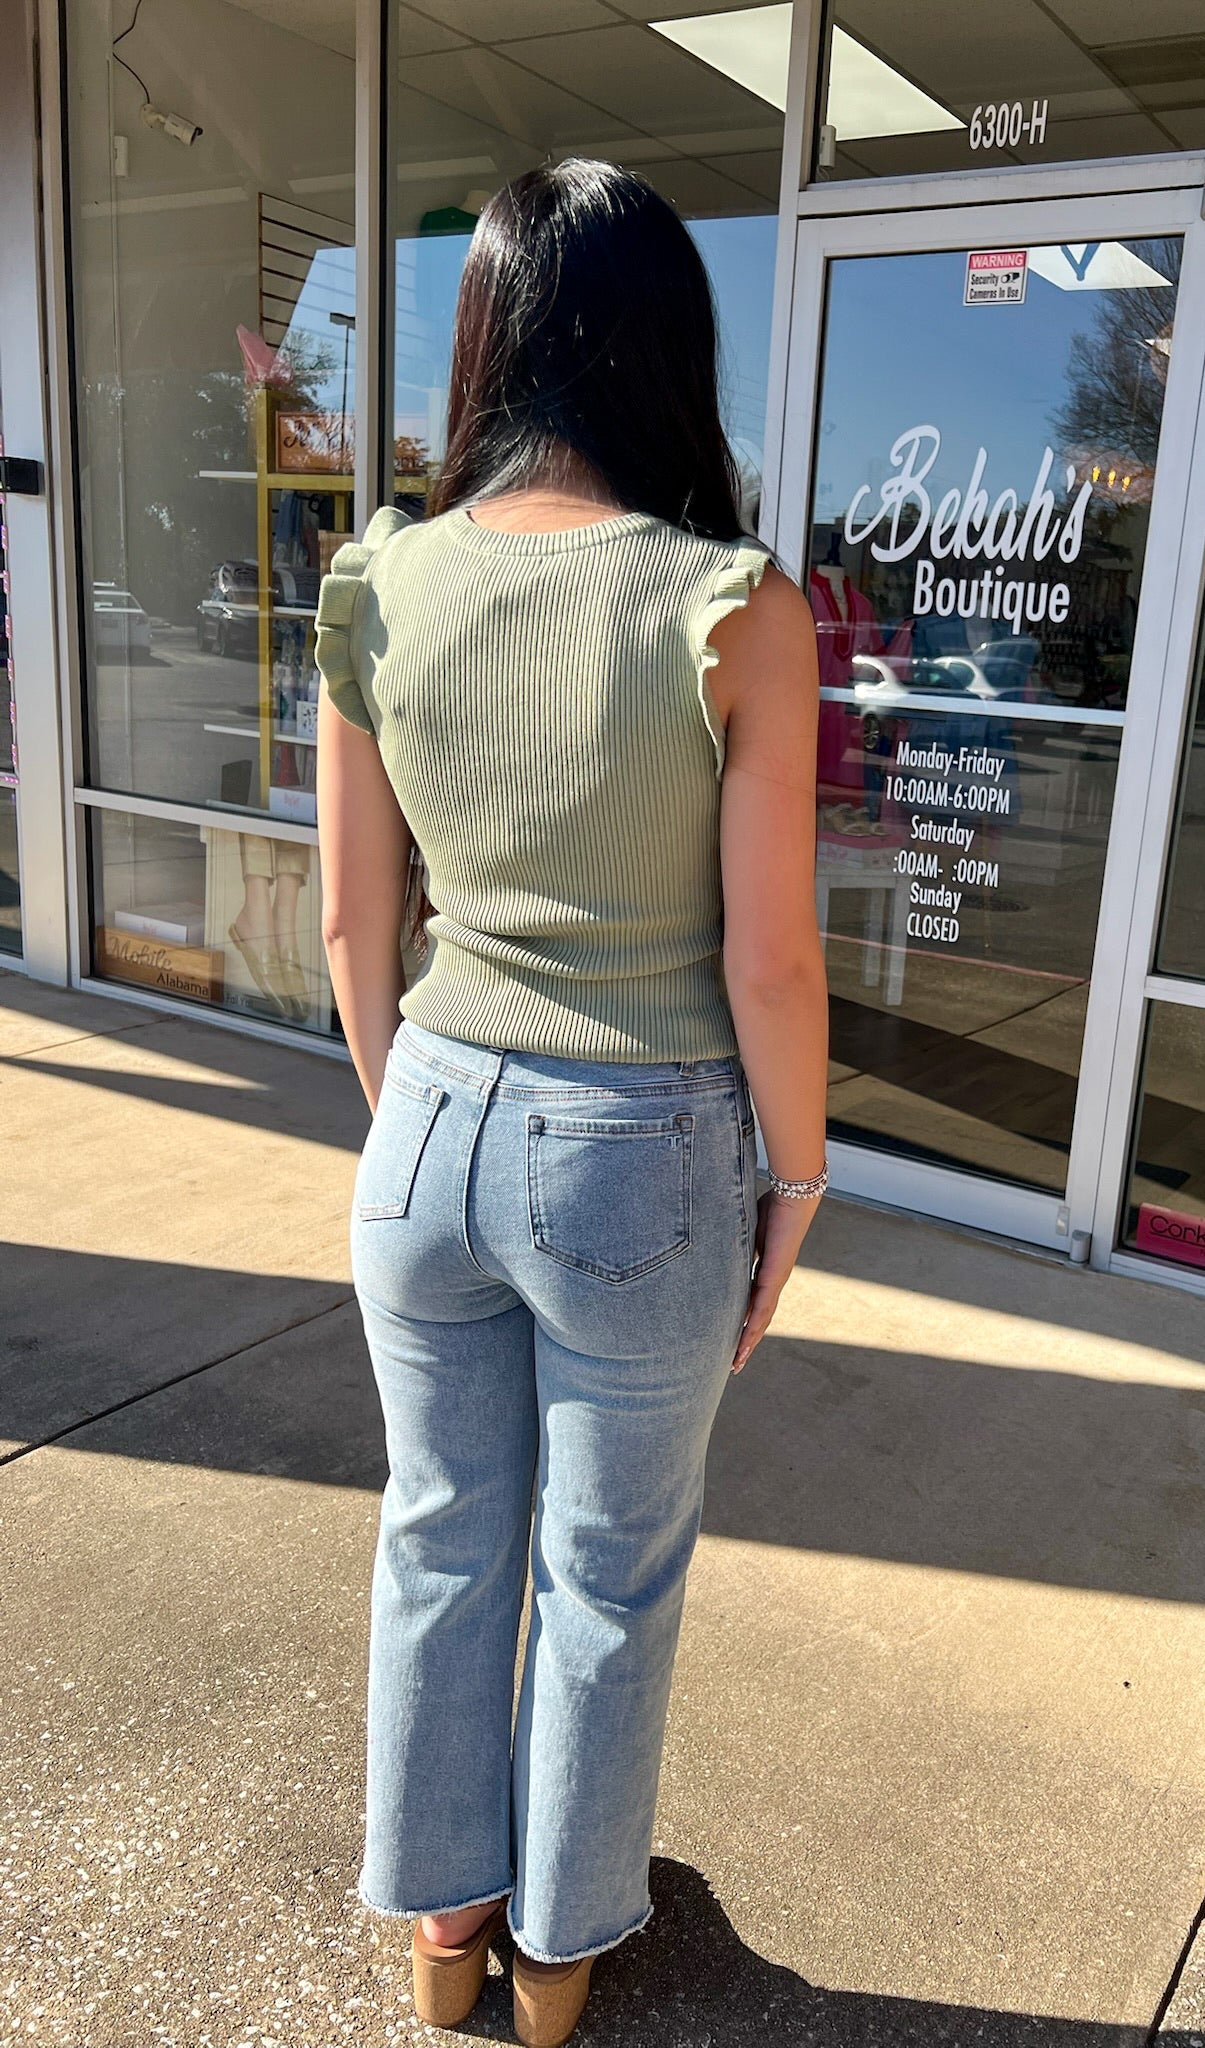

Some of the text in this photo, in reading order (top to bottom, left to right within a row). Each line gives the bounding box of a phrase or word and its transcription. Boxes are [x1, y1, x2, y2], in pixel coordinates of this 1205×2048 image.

[969, 99, 1049, 150] 6300-H
[971, 254, 1023, 269] WARNING
[969, 286, 1019, 299] Cameras In Use
[971, 273, 999, 287] Security
[844, 425, 1093, 564] Bekah's
[913, 559, 1071, 635] Boutique
[896, 741, 1005, 783] Monday-Friday
[885, 776, 1011, 815] 10:00AM-6:00PM
[910, 815, 975, 852] Saturday
[951, 859, 999, 889] :00PM
[909, 882, 962, 915] Sunday
[906, 912, 960, 943] CLOSED
[155, 972, 210, 997] Alabama
